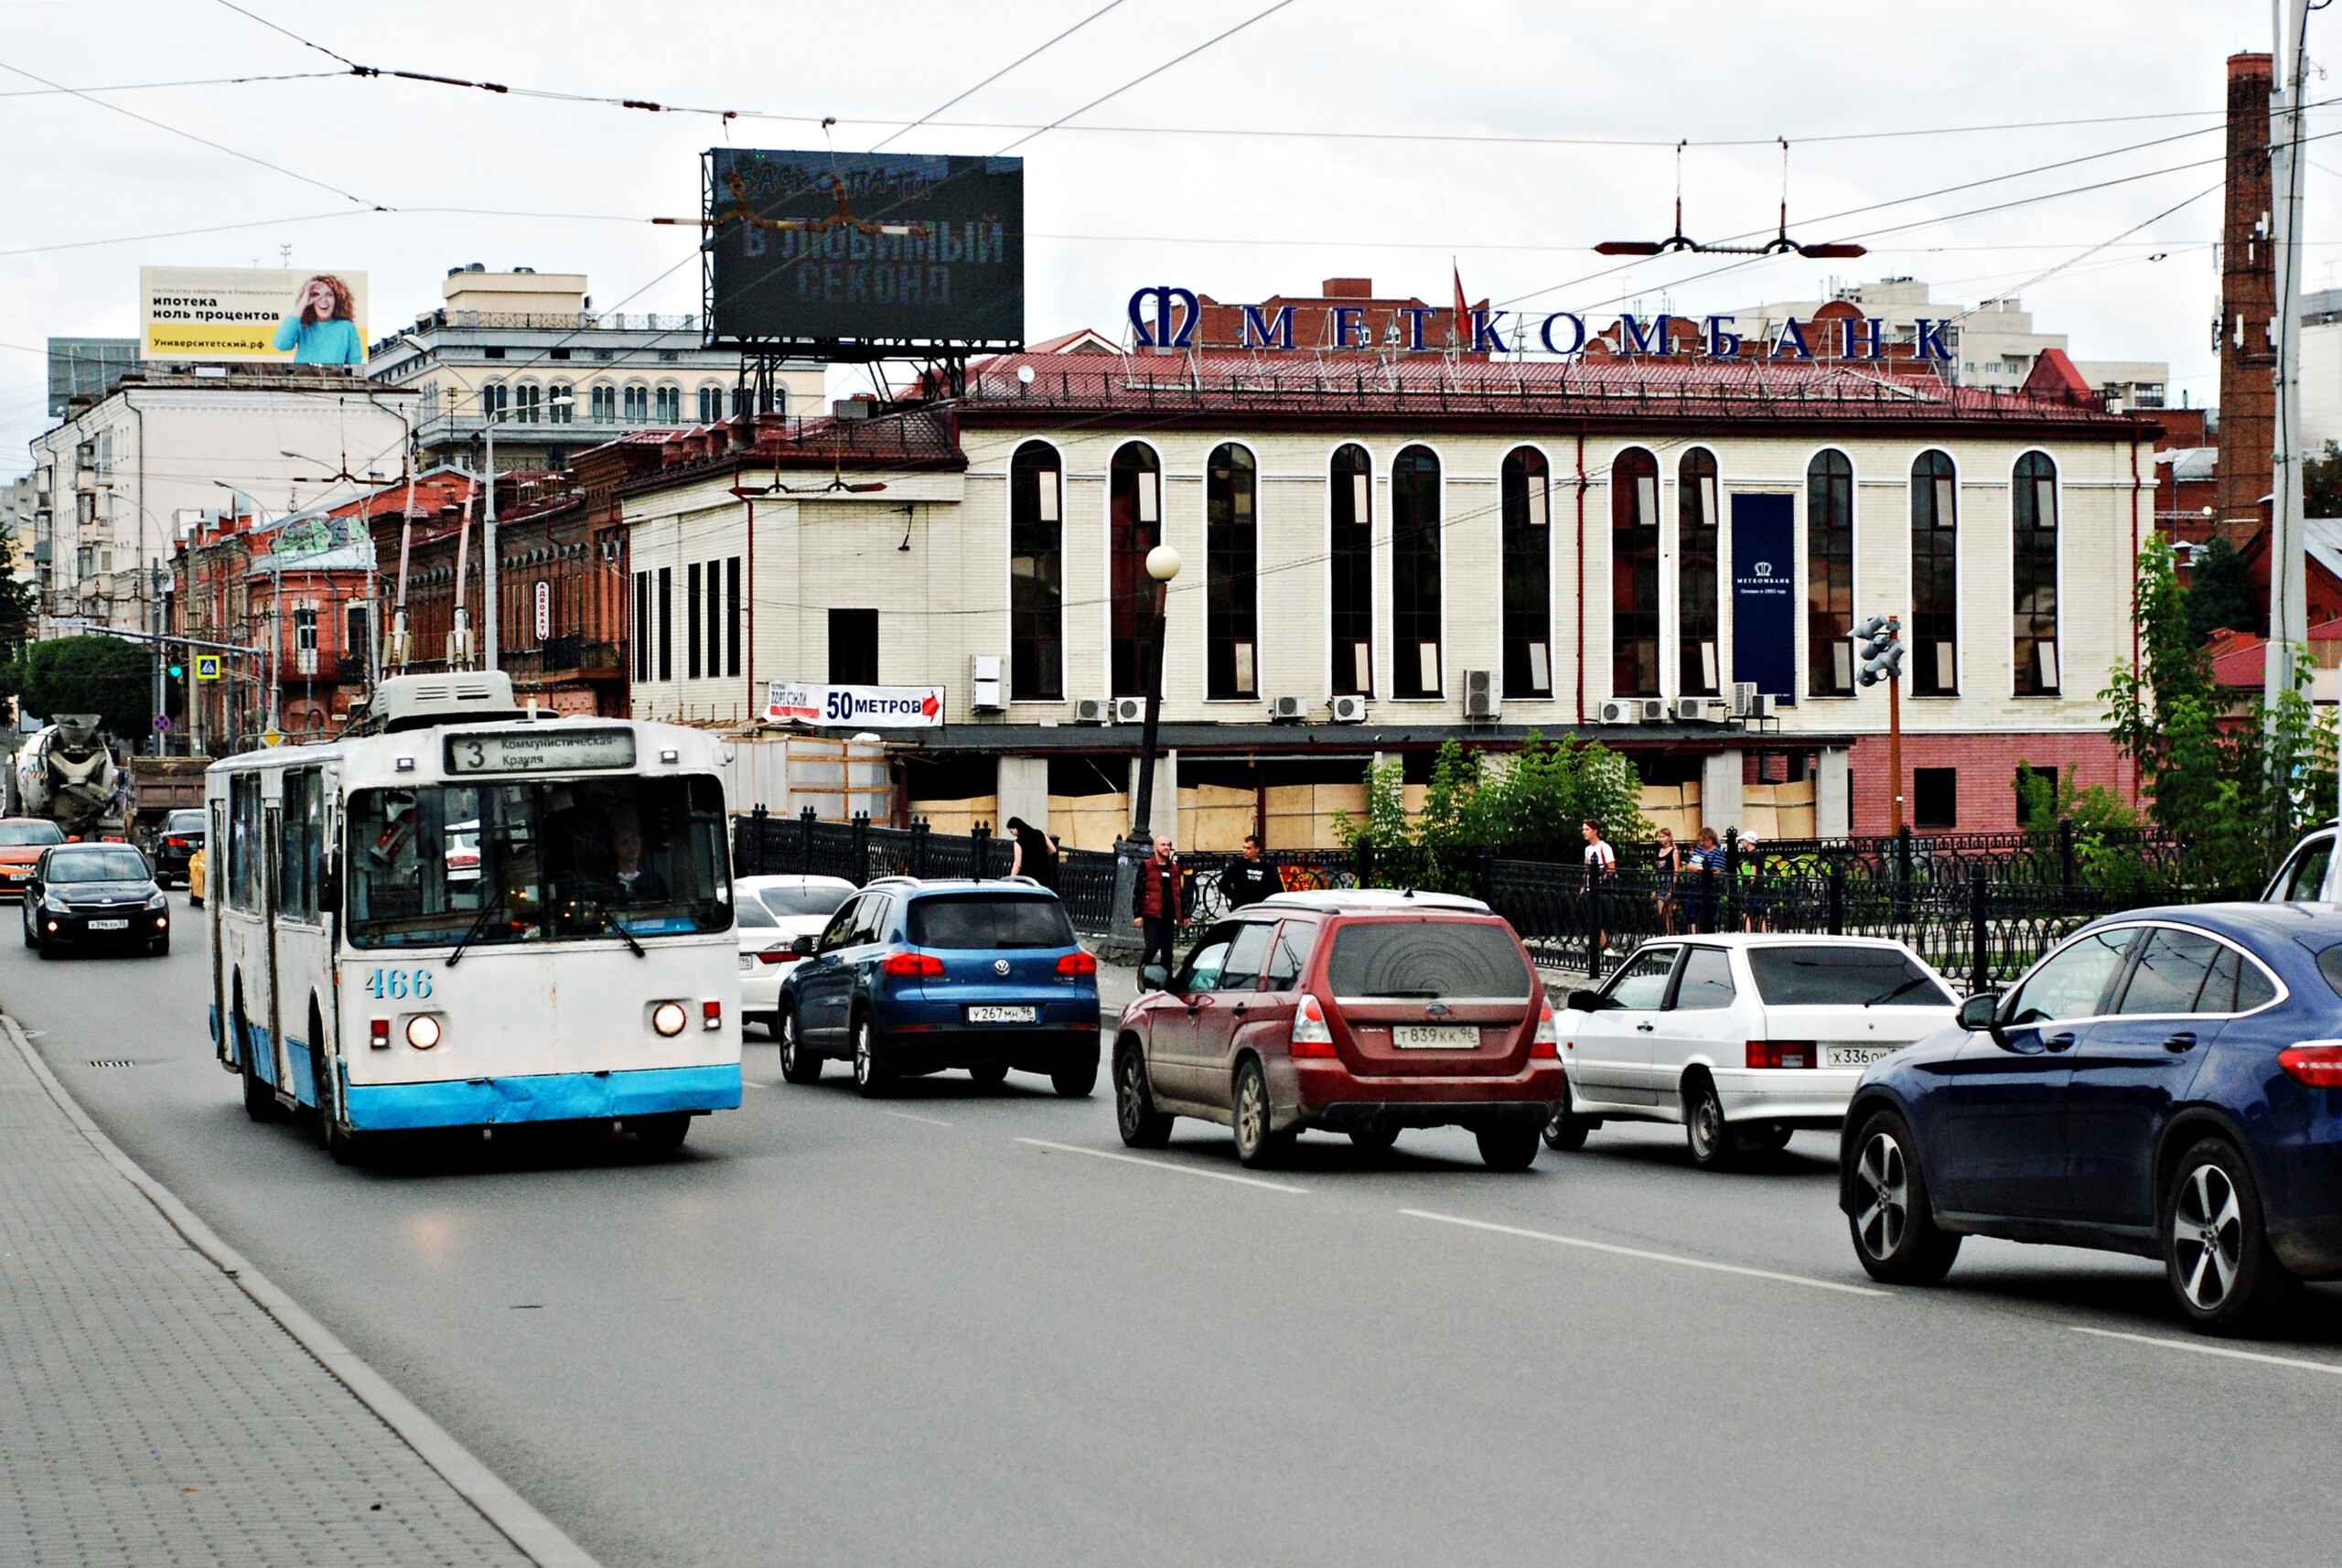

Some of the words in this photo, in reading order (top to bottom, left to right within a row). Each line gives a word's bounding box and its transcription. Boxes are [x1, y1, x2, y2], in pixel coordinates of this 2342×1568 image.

[153, 296, 218, 306] ипотека
[153, 308, 191, 319] ноль
[195, 310, 280, 322] процентов
[1241, 305, 1953, 360] МЕТКОМБАНК
[154, 338, 264, 350] Университетский.рф
[826, 692, 853, 720] 50
[855, 699, 922, 714] МЕТРОВ
[467, 740, 485, 768] 3
[502, 755, 543, 768] Крауля
[366, 969, 433, 1000] 466
